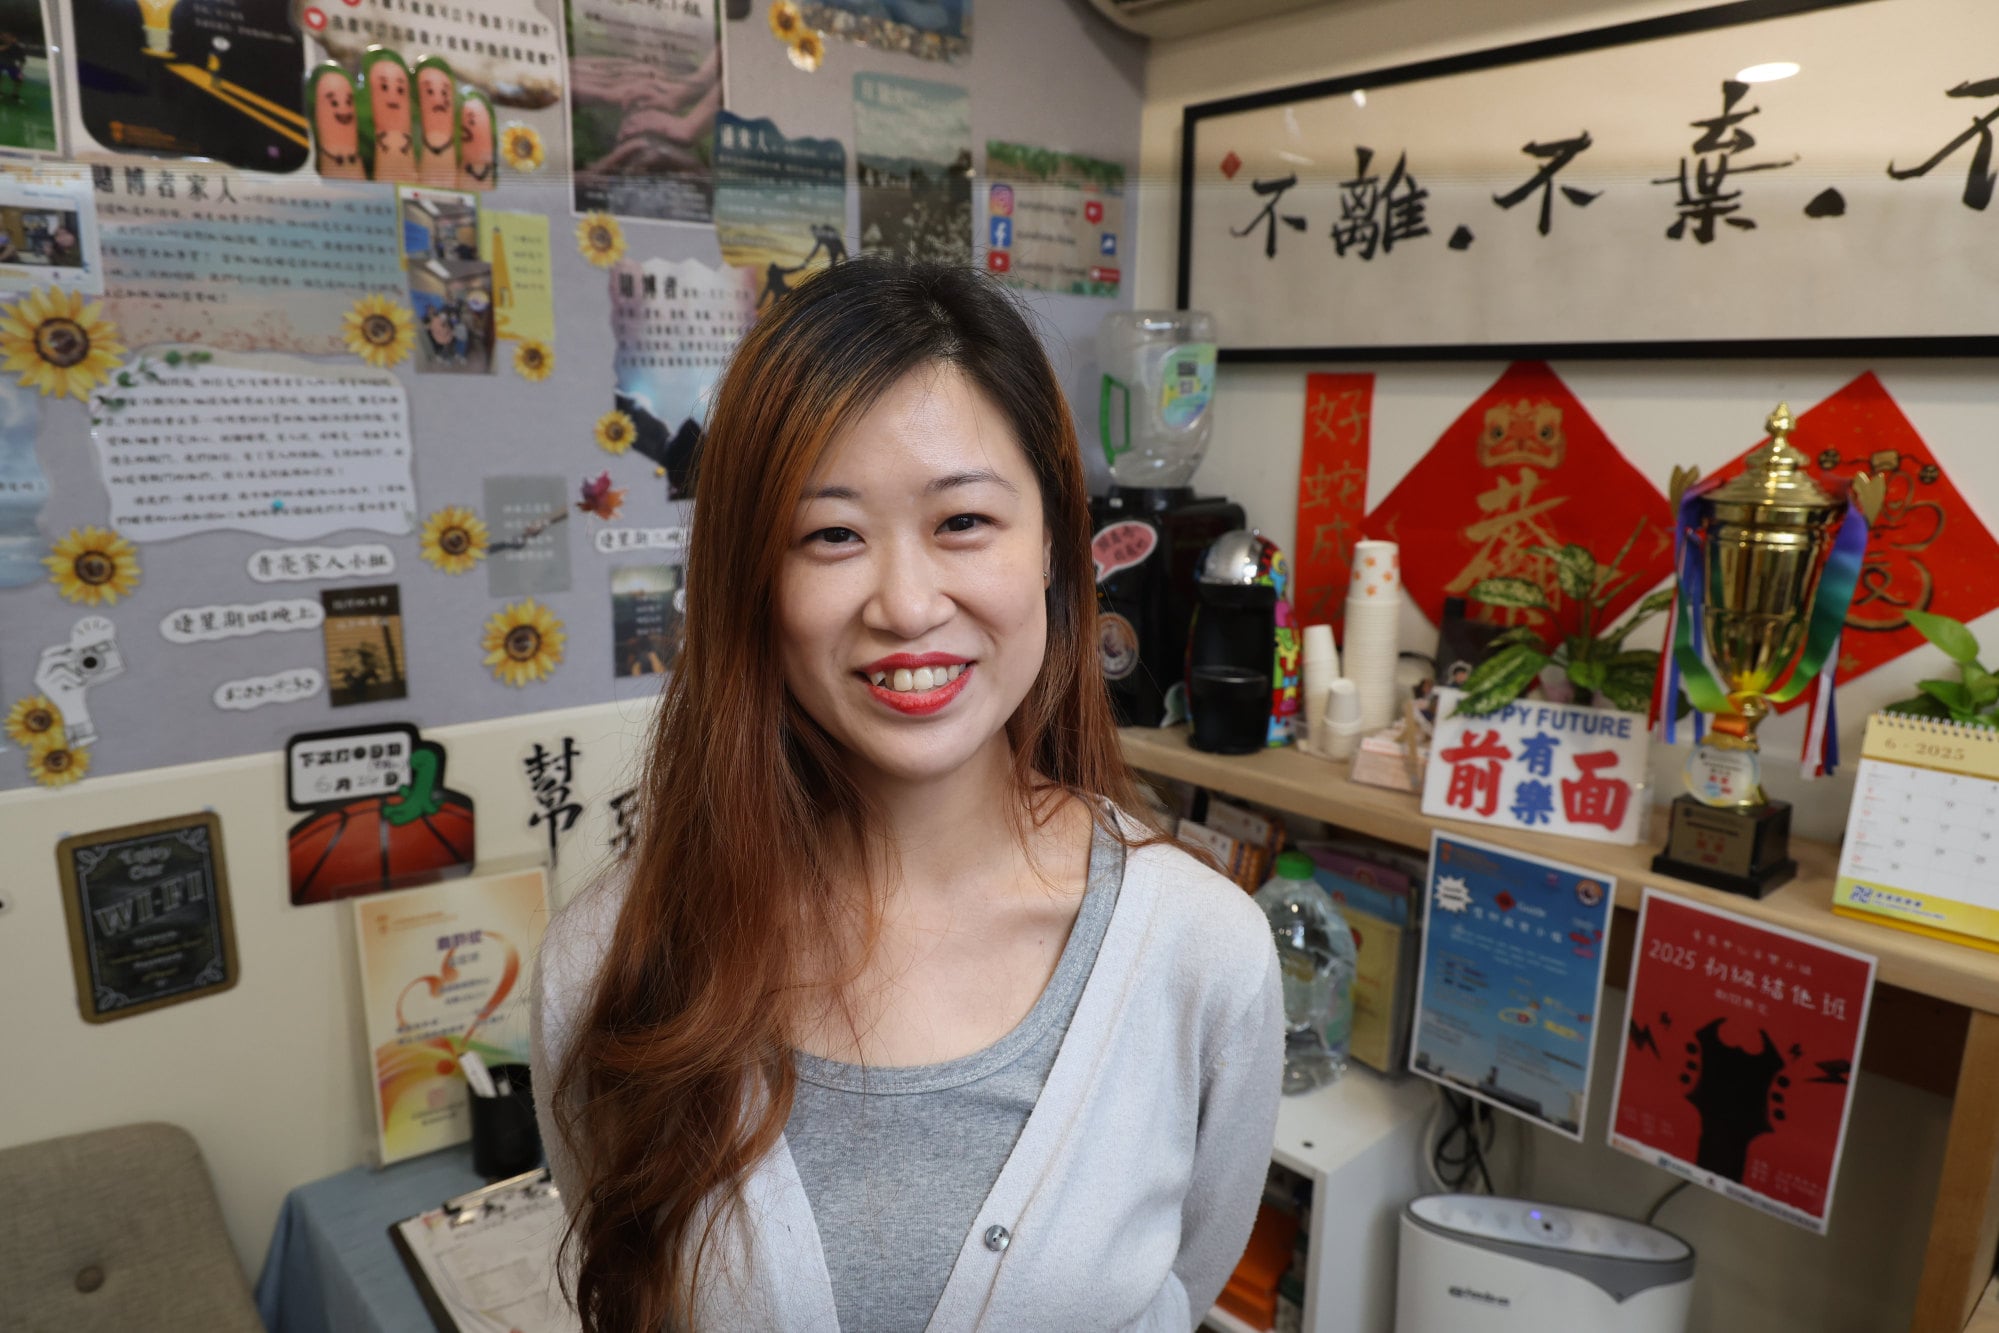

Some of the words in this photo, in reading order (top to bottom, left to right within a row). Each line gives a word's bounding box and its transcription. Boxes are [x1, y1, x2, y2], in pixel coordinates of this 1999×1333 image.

[1536, 707, 1632, 739] FUTURE
[1915, 741, 1966, 762] 2025
[1649, 938, 1698, 971] 2025
